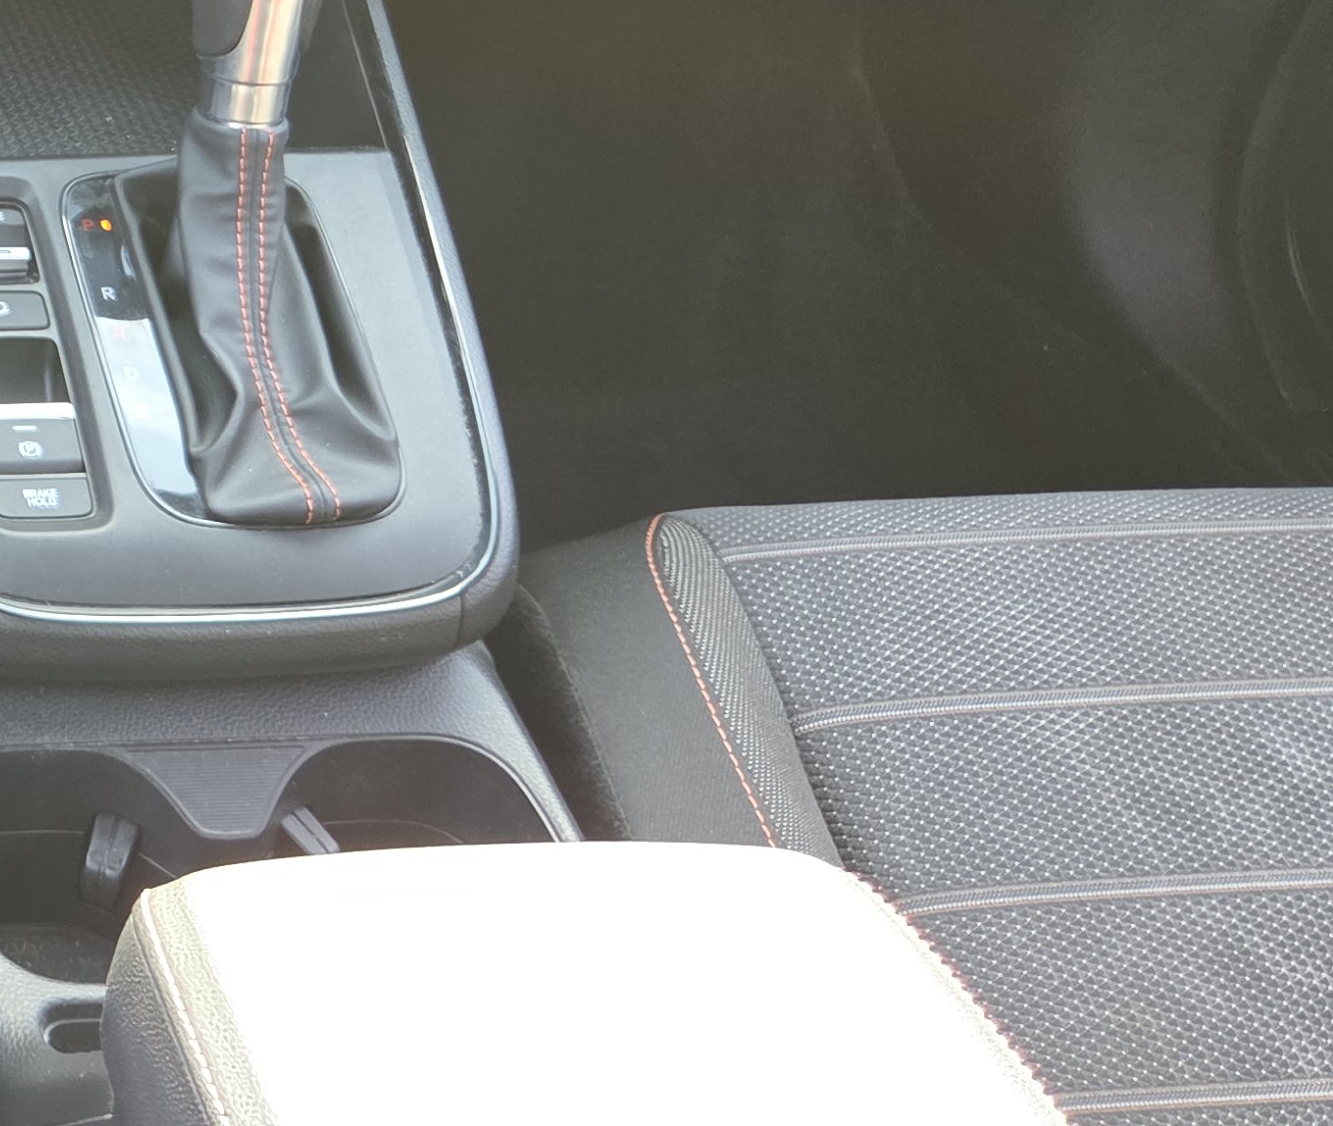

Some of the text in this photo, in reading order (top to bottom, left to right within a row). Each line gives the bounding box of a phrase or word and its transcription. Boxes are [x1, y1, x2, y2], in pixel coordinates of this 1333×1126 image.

[101, 286, 117, 301] R
[22, 488, 59, 498] BRAKE
[26, 496, 59, 507] HOLD
